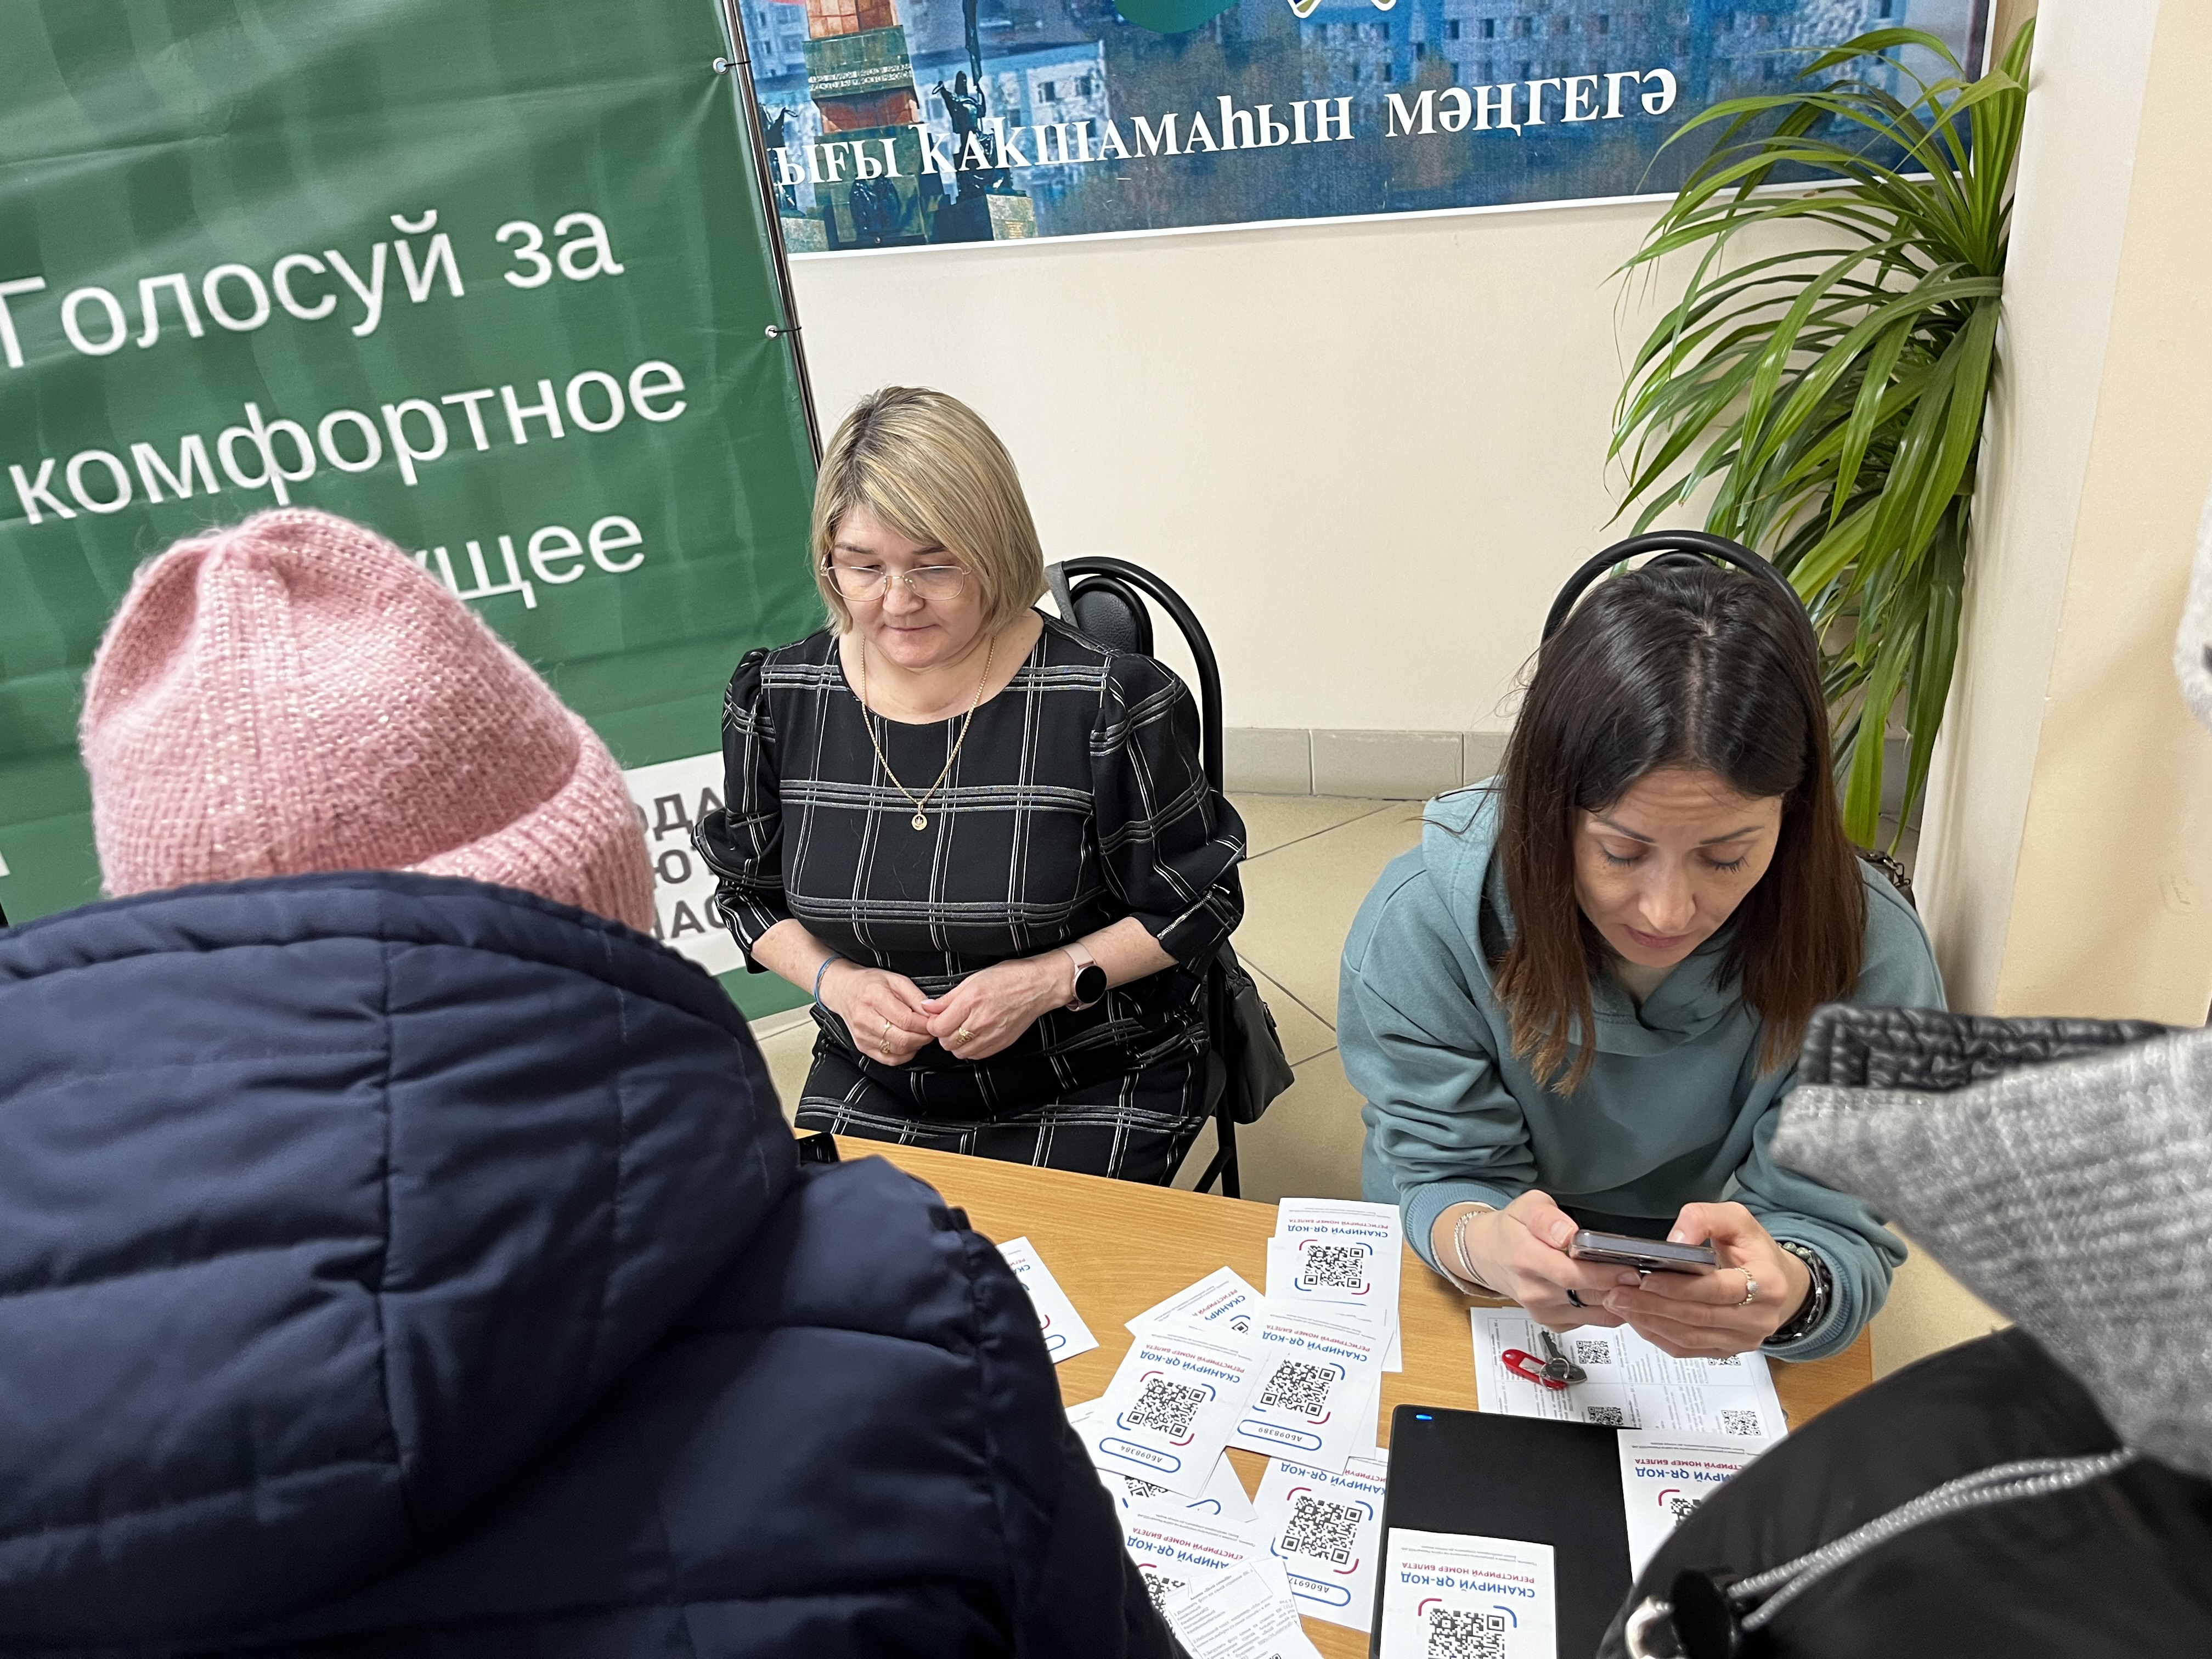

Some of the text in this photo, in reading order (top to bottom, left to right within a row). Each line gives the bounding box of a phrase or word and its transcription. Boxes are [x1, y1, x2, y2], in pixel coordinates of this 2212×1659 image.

[769, 137, 902, 185] ЫҒЫ
[0, 210, 624, 368] Голосуй за
[9, 360, 686, 524] комфортное
[415, 516, 644, 608] щее
[1331, 1228, 1389, 1238] СКАНИРУЙ
[1146, 1345, 1171, 1353] БИЛЕТА
[1262, 1331, 1368, 1362] СКАНИРУЙ QR-КОД
[1321, 1336, 1370, 1352] РЕГИСТРИРУЙ
[1141, 1351, 1240, 1383] СКАНИРУЙ QR-КОД
[1198, 1356, 1245, 1373] РЕГИСТРИРУЙ
[1344, 1470, 1387, 1482] ИСТРИРУЙ
[1635, 1467, 1690, 1479] QR-КОД
[1703, 1462, 1743, 1470] СТРИРУЙ
[1281, 1463, 1386, 1494] КАНИРУЙ QR-КОД
[1127, 1536, 1229, 1569] АНИРУЙ QR-КОД
[1133, 1528, 1243, 1560] ЕГИСТРИРУЙ НОМЕР БИЛЕТА
[1402, 1563, 1436, 1571] БИЛЕТА
[1472, 1571, 1535, 1583] РЕГИСТРИРУЙ
[1289, 1578, 1329, 1593] АБ06917
[1401, 1572, 1535, 1598] СКАНИРУЙ QR-КОД
